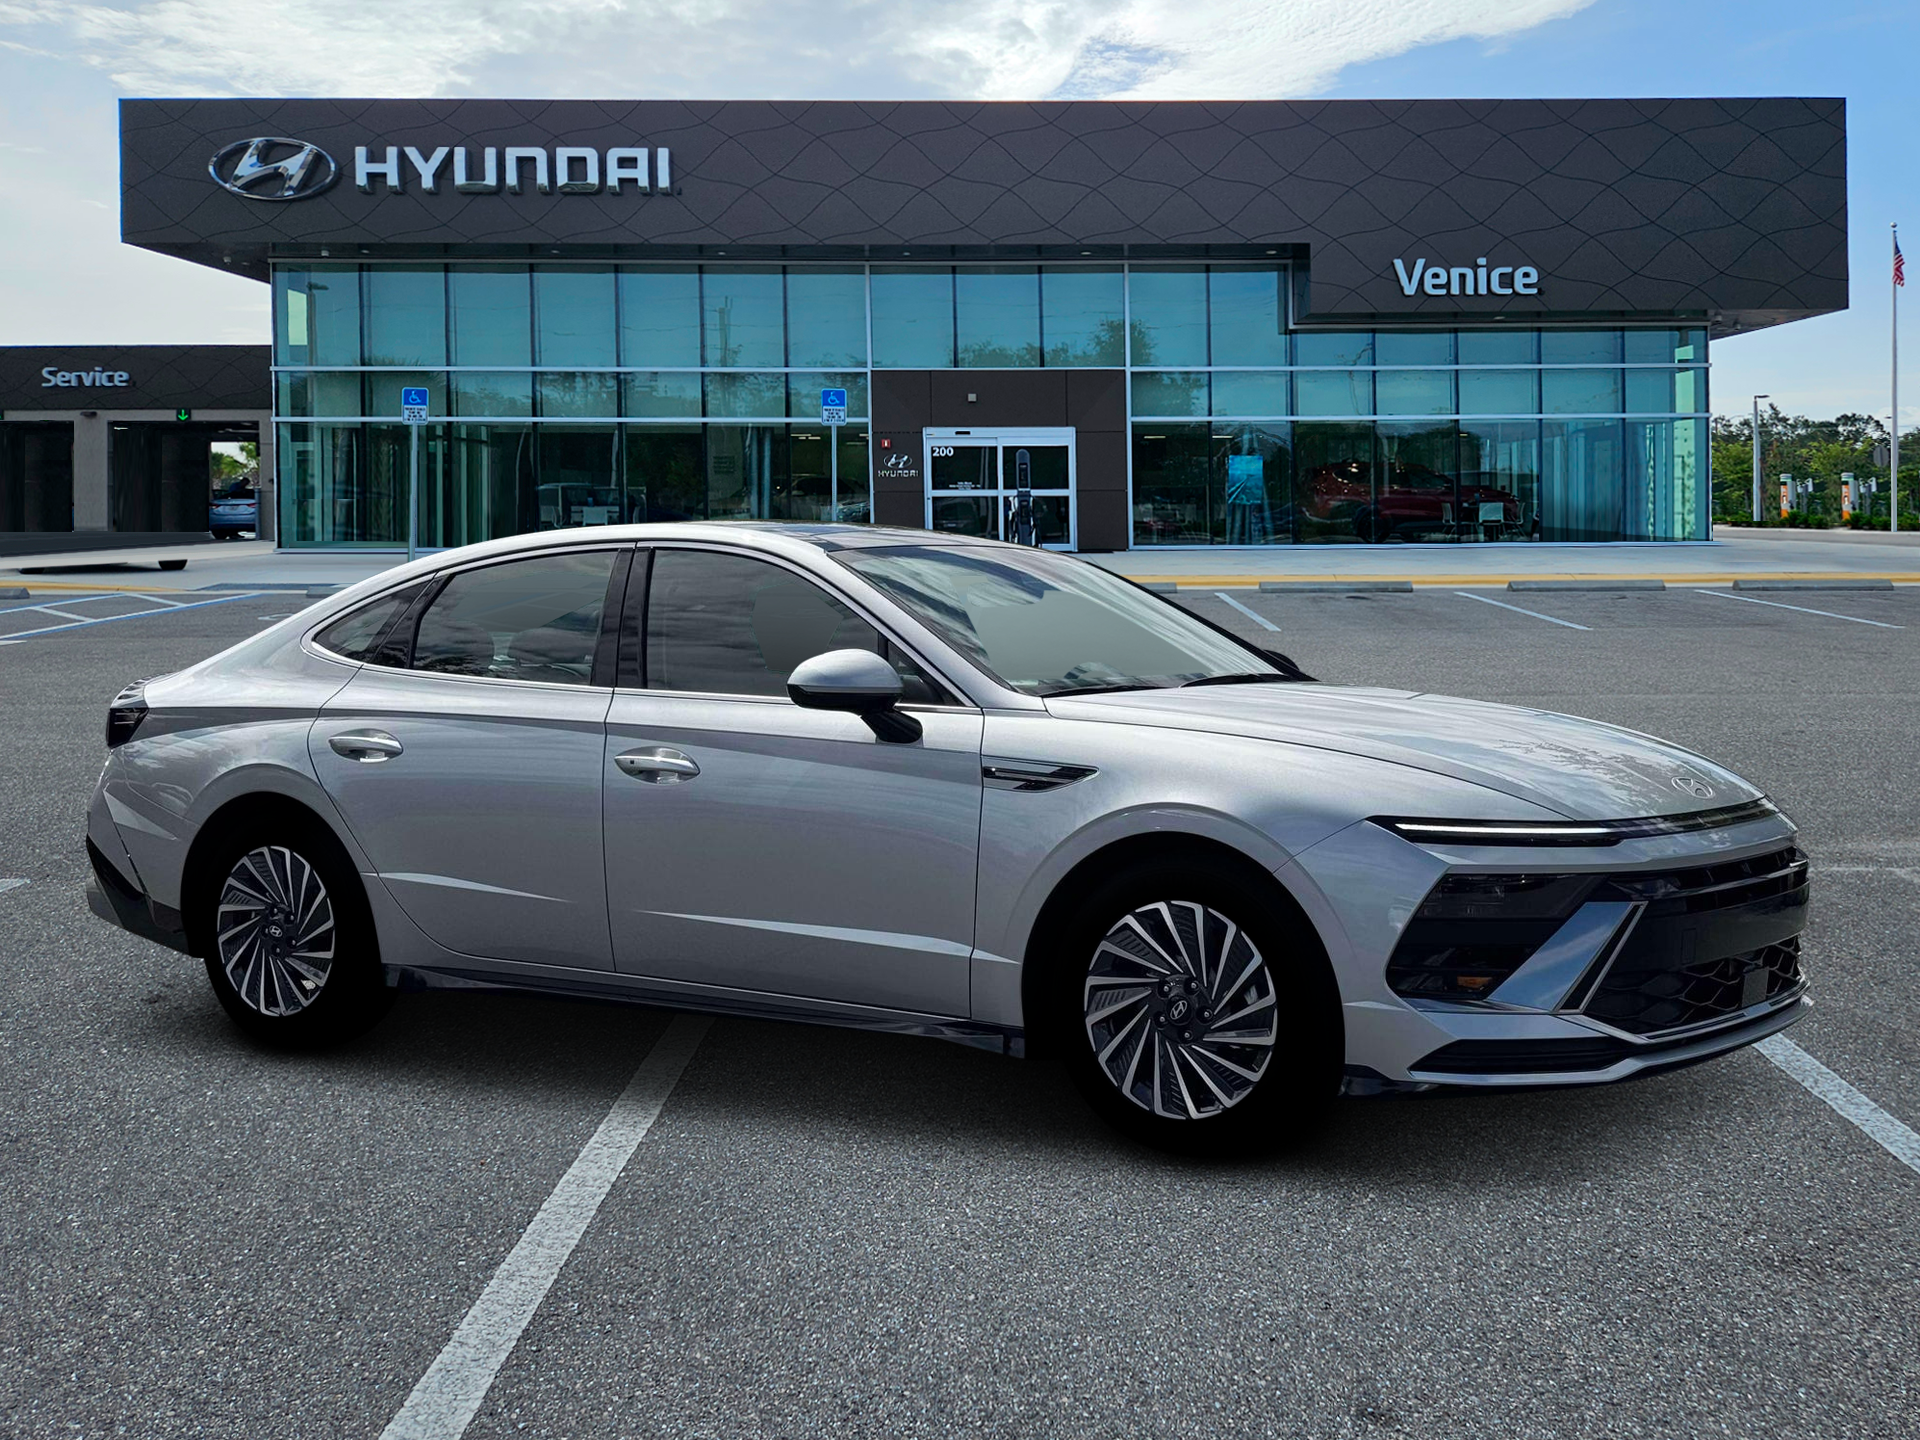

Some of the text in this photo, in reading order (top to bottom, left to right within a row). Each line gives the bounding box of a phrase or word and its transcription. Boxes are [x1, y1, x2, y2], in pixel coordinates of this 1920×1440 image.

[354, 146, 672, 194] HYUNDAI
[1392, 257, 1539, 296] Venice
[41, 366, 130, 387] Service
[932, 446, 954, 457] 200
[877, 469, 919, 478] HYUNDAI
